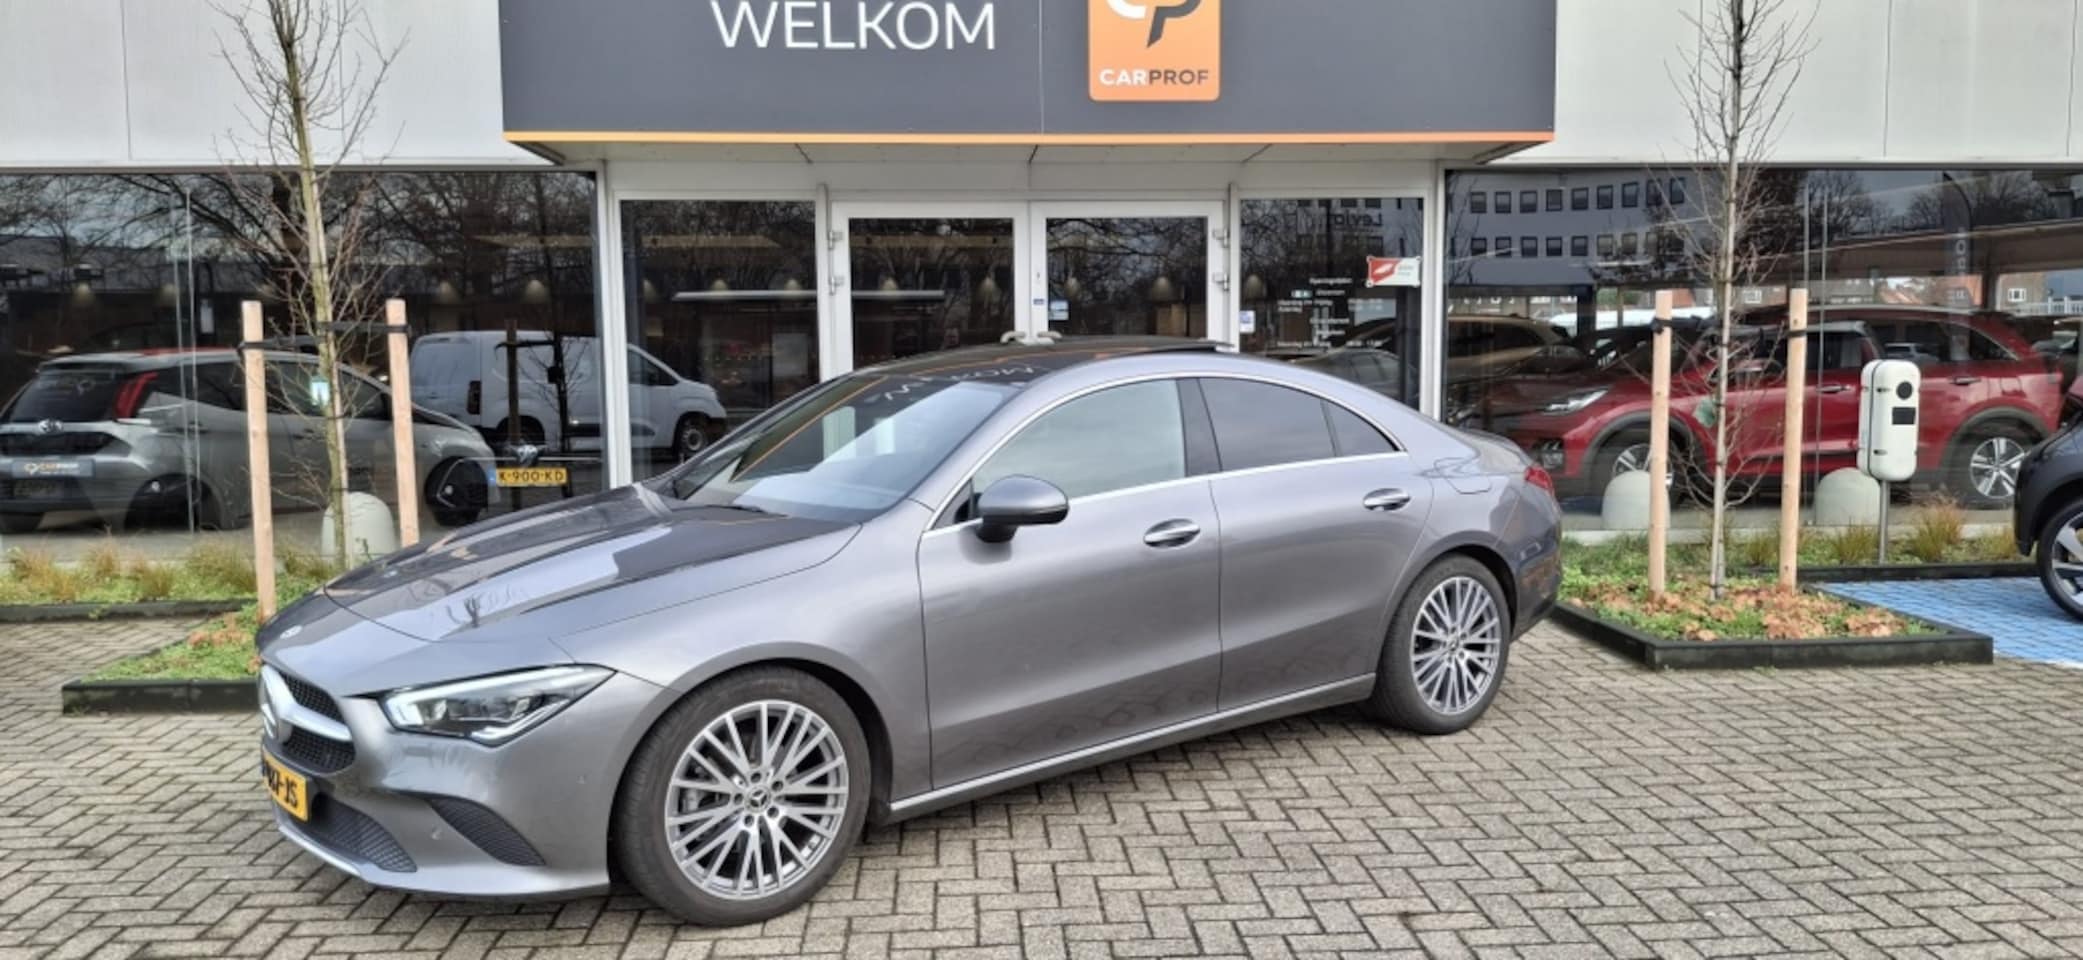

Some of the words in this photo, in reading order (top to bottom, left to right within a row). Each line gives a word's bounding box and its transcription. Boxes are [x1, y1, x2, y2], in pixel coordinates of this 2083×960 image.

[710, 0, 995, 50] WELKOM
[1099, 69, 1209, 86] CARPROF
[498, 470, 564, 482] K-900-KD
